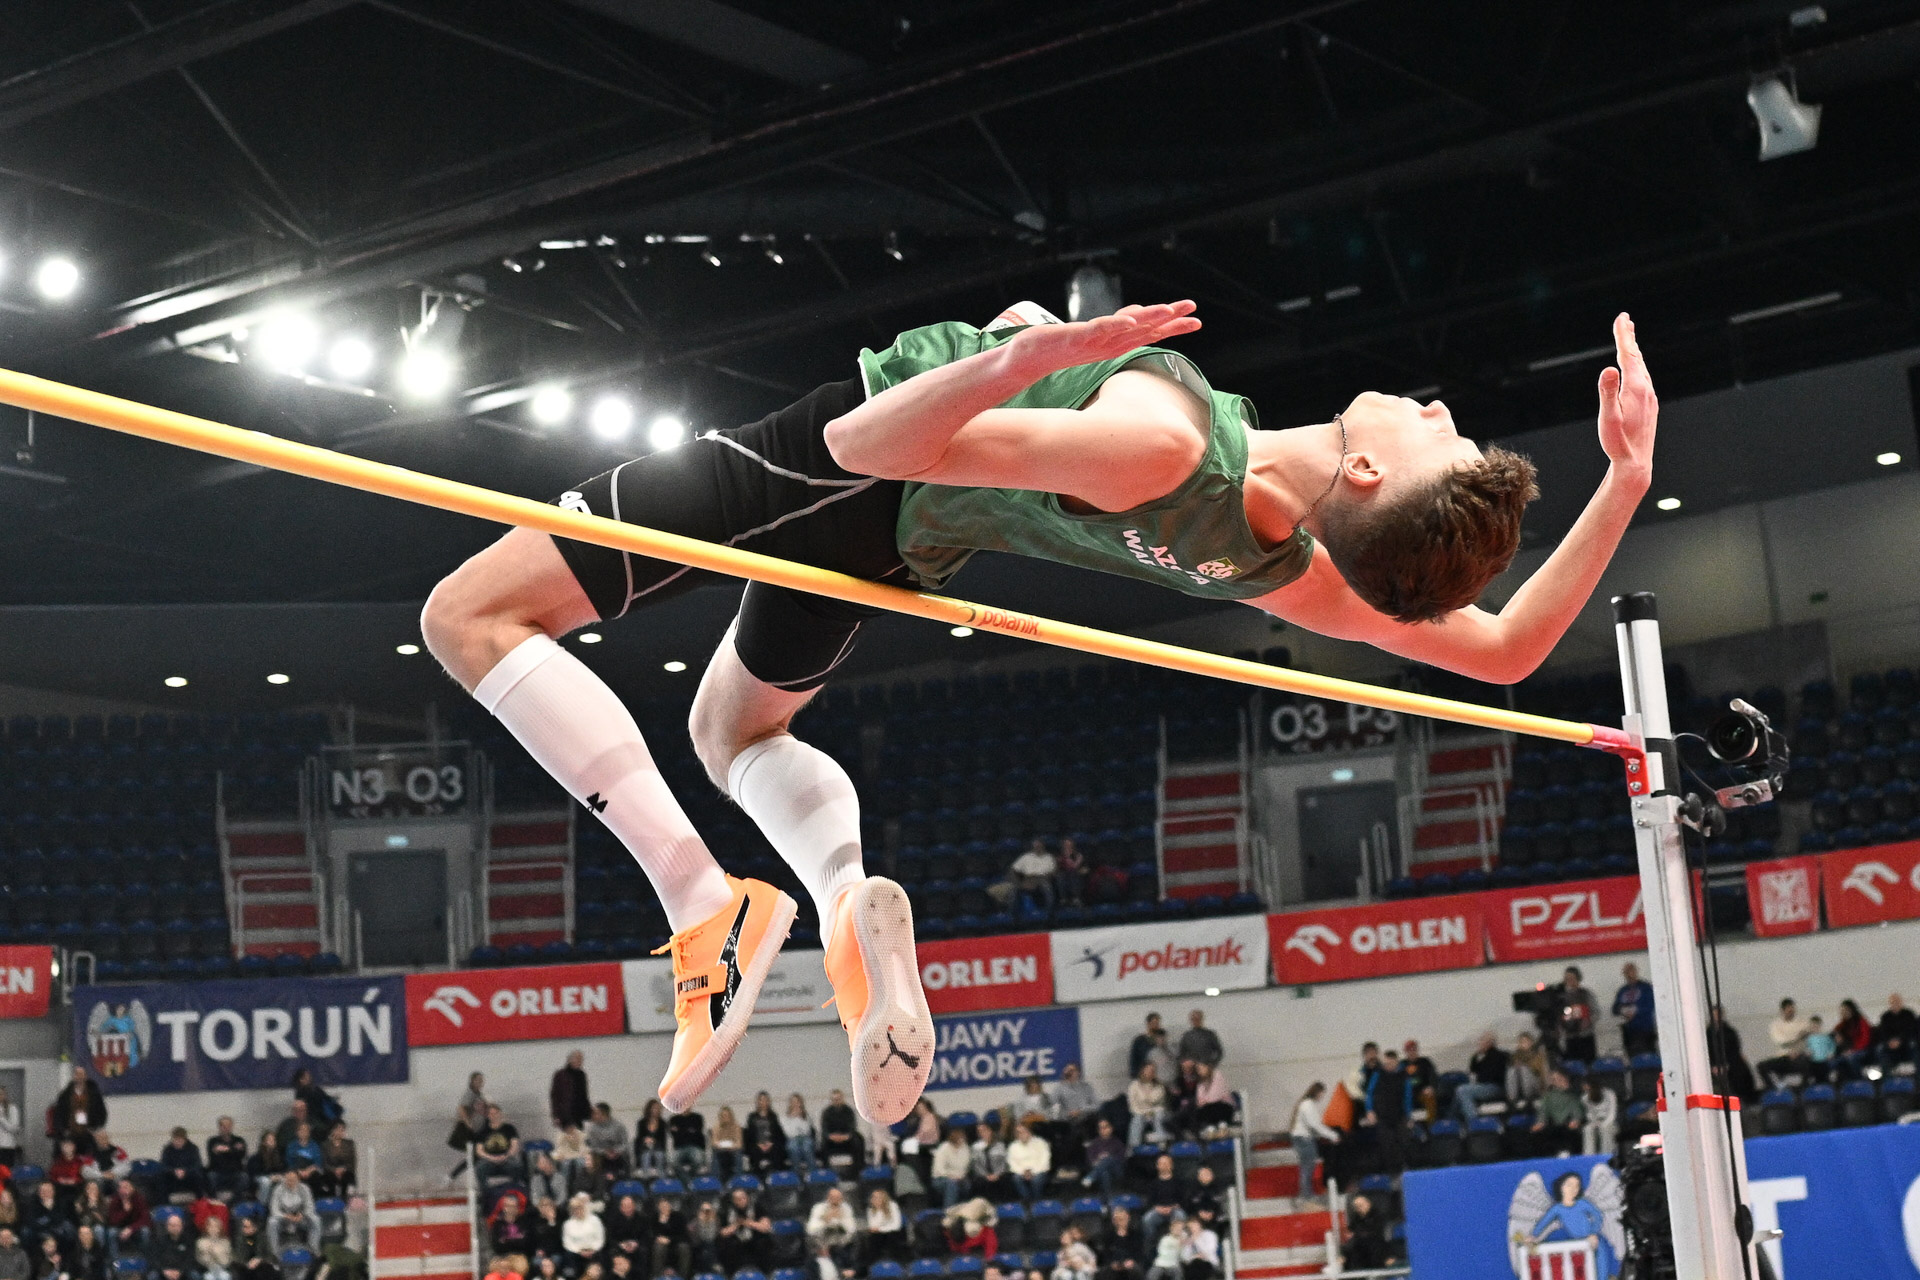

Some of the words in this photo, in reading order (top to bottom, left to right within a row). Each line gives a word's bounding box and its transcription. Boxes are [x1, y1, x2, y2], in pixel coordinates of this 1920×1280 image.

[977, 609, 1040, 636] polanik
[332, 768, 387, 805] N3
[405, 765, 463, 803] O3
[1350, 916, 1467, 954] ORLEN
[921, 955, 1038, 991] ORLEN
[1117, 937, 1244, 980] polanik
[490, 984, 608, 1018] ORLEN
[157, 987, 393, 1062] TORUŃ
[937, 1018, 1027, 1051] JAWY
